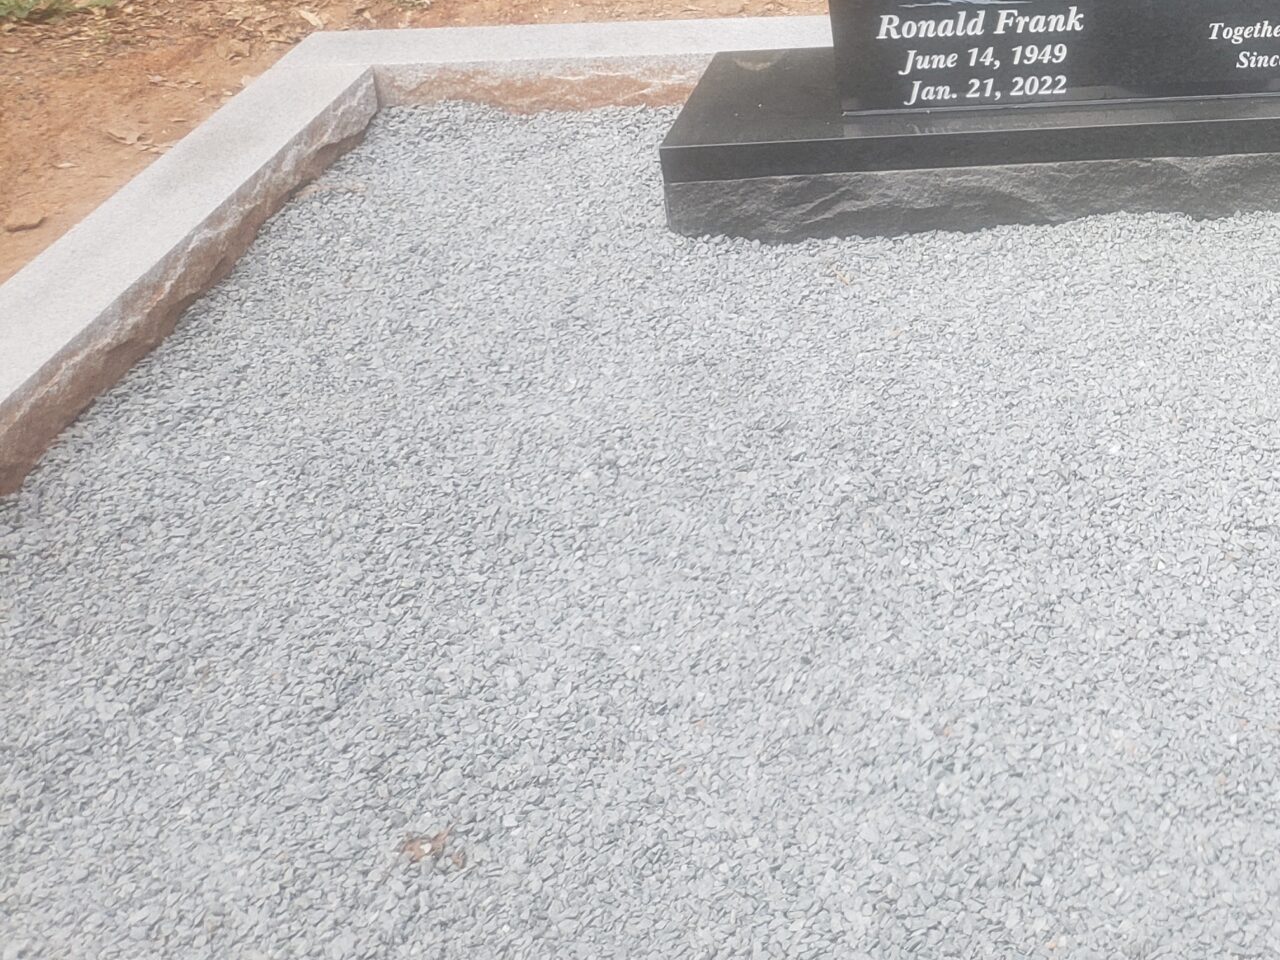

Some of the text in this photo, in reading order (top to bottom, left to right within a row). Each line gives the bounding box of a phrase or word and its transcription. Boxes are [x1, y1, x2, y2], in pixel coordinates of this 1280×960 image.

[875, 6, 1085, 40] Ronald Frank
[898, 43, 1068, 76] June 14, 1949
[903, 75, 1067, 106] Jan. 21, 2022
